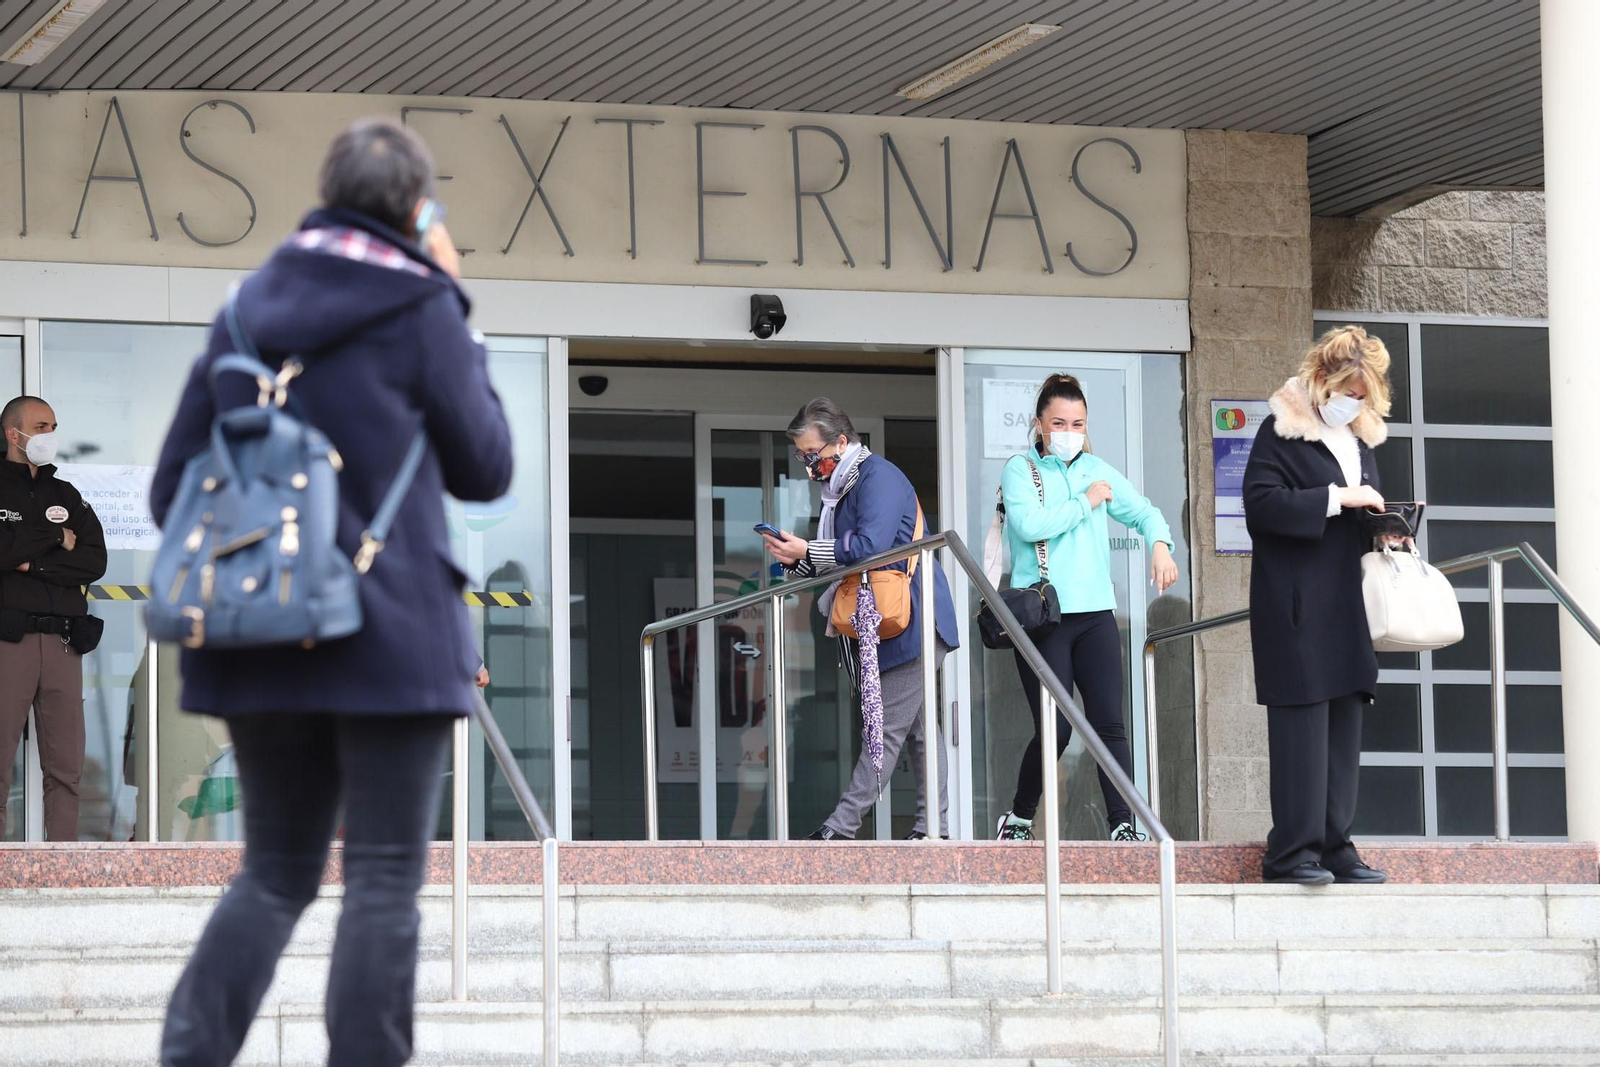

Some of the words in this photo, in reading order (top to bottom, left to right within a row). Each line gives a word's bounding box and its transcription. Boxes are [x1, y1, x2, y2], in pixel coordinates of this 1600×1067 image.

[93, 489, 131, 498] acceder
[133, 490, 142, 499] al
[123, 503, 134, 511] es
[111, 514, 119, 523] el
[122, 516, 140, 524] uso
